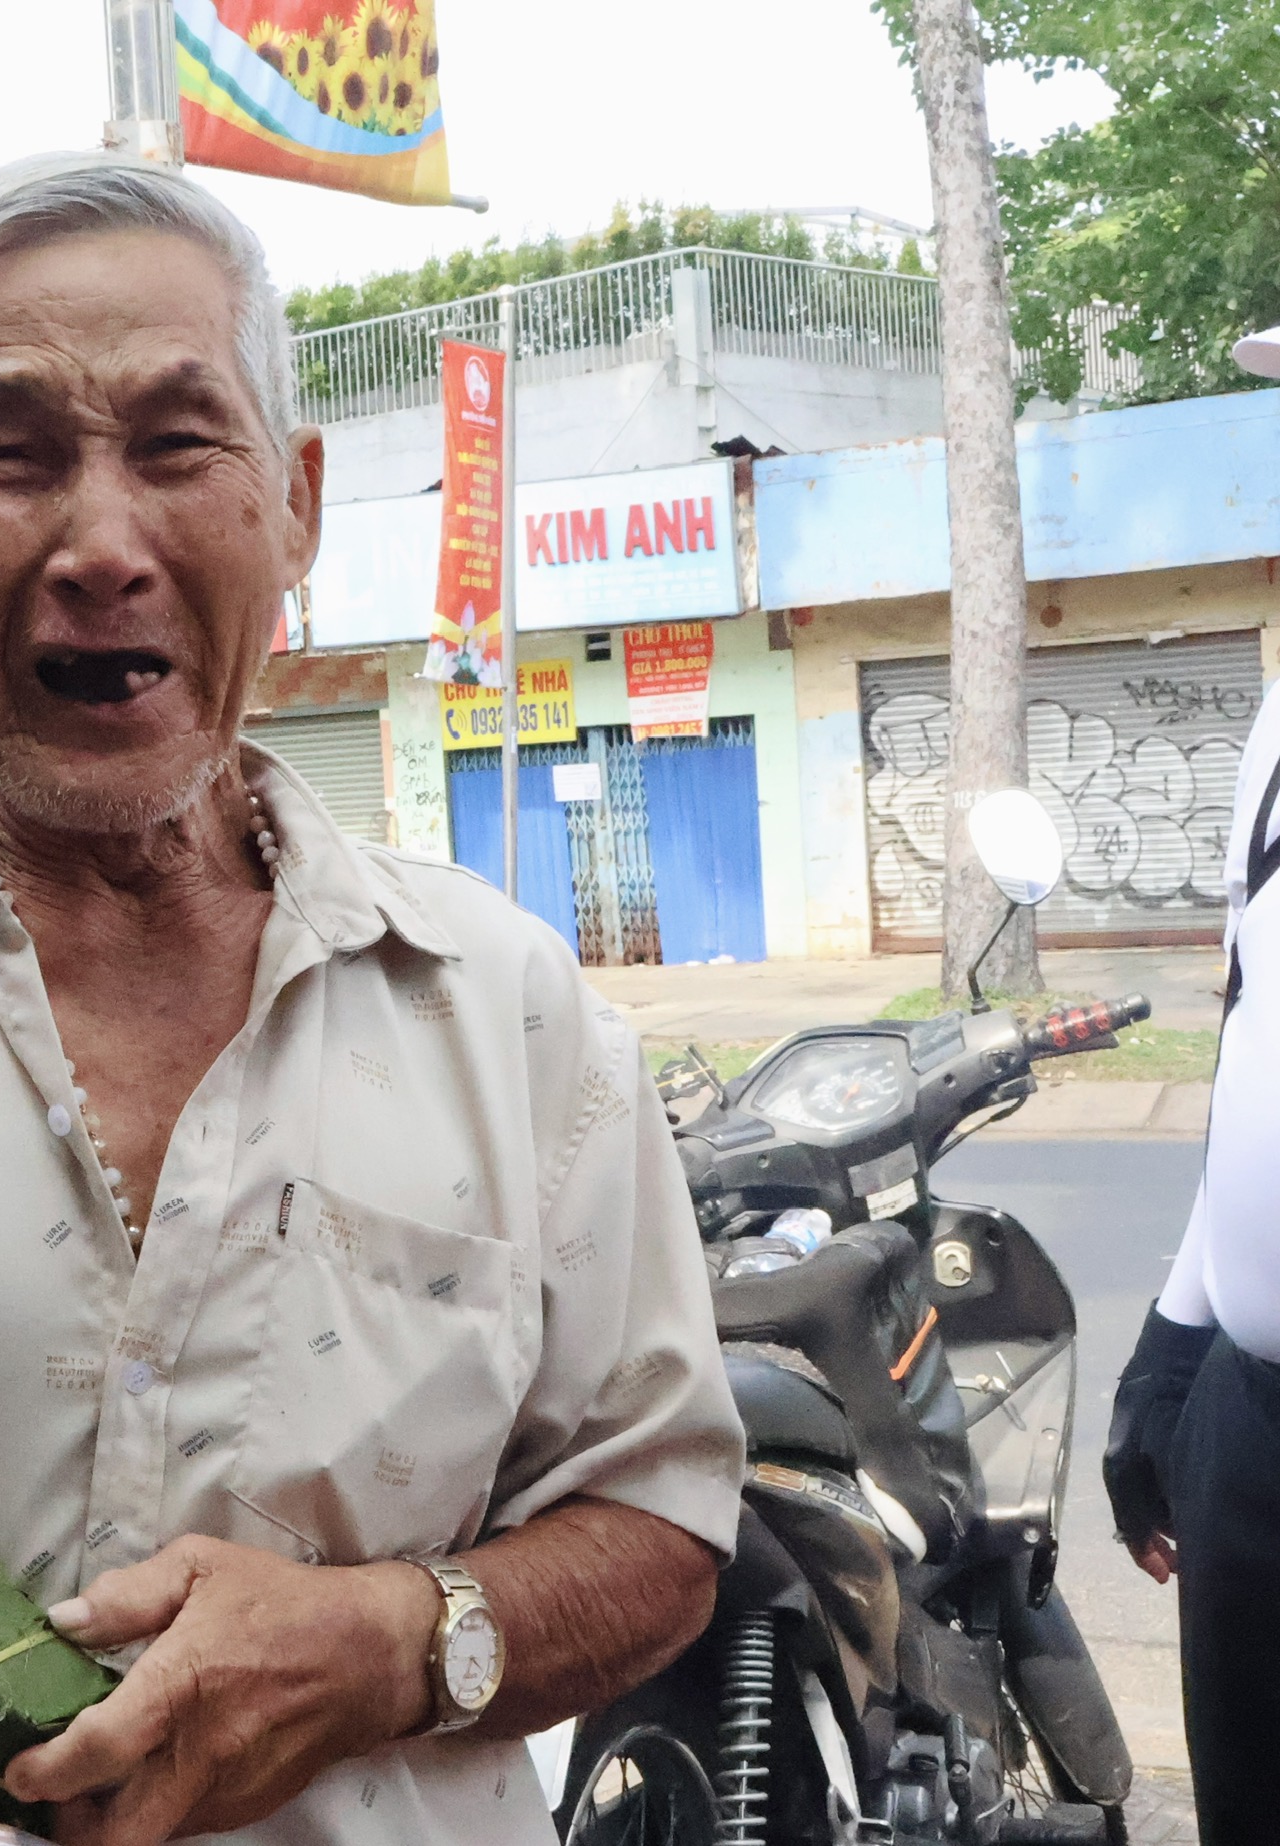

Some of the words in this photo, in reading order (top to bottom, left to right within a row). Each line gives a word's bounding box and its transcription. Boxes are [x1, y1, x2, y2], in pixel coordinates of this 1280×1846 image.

[525, 507, 609, 567] KIM
[624, 496, 716, 557] ANH
[532, 663, 569, 694] NHÀ
[543, 700, 569, 730] 141
[153, 1196, 185, 1218] LUREN
[42, 1219, 68, 1244] LUREN
[308, 1329, 336, 1349] LUREN
[184, 1435, 215, 1459] LUREN
